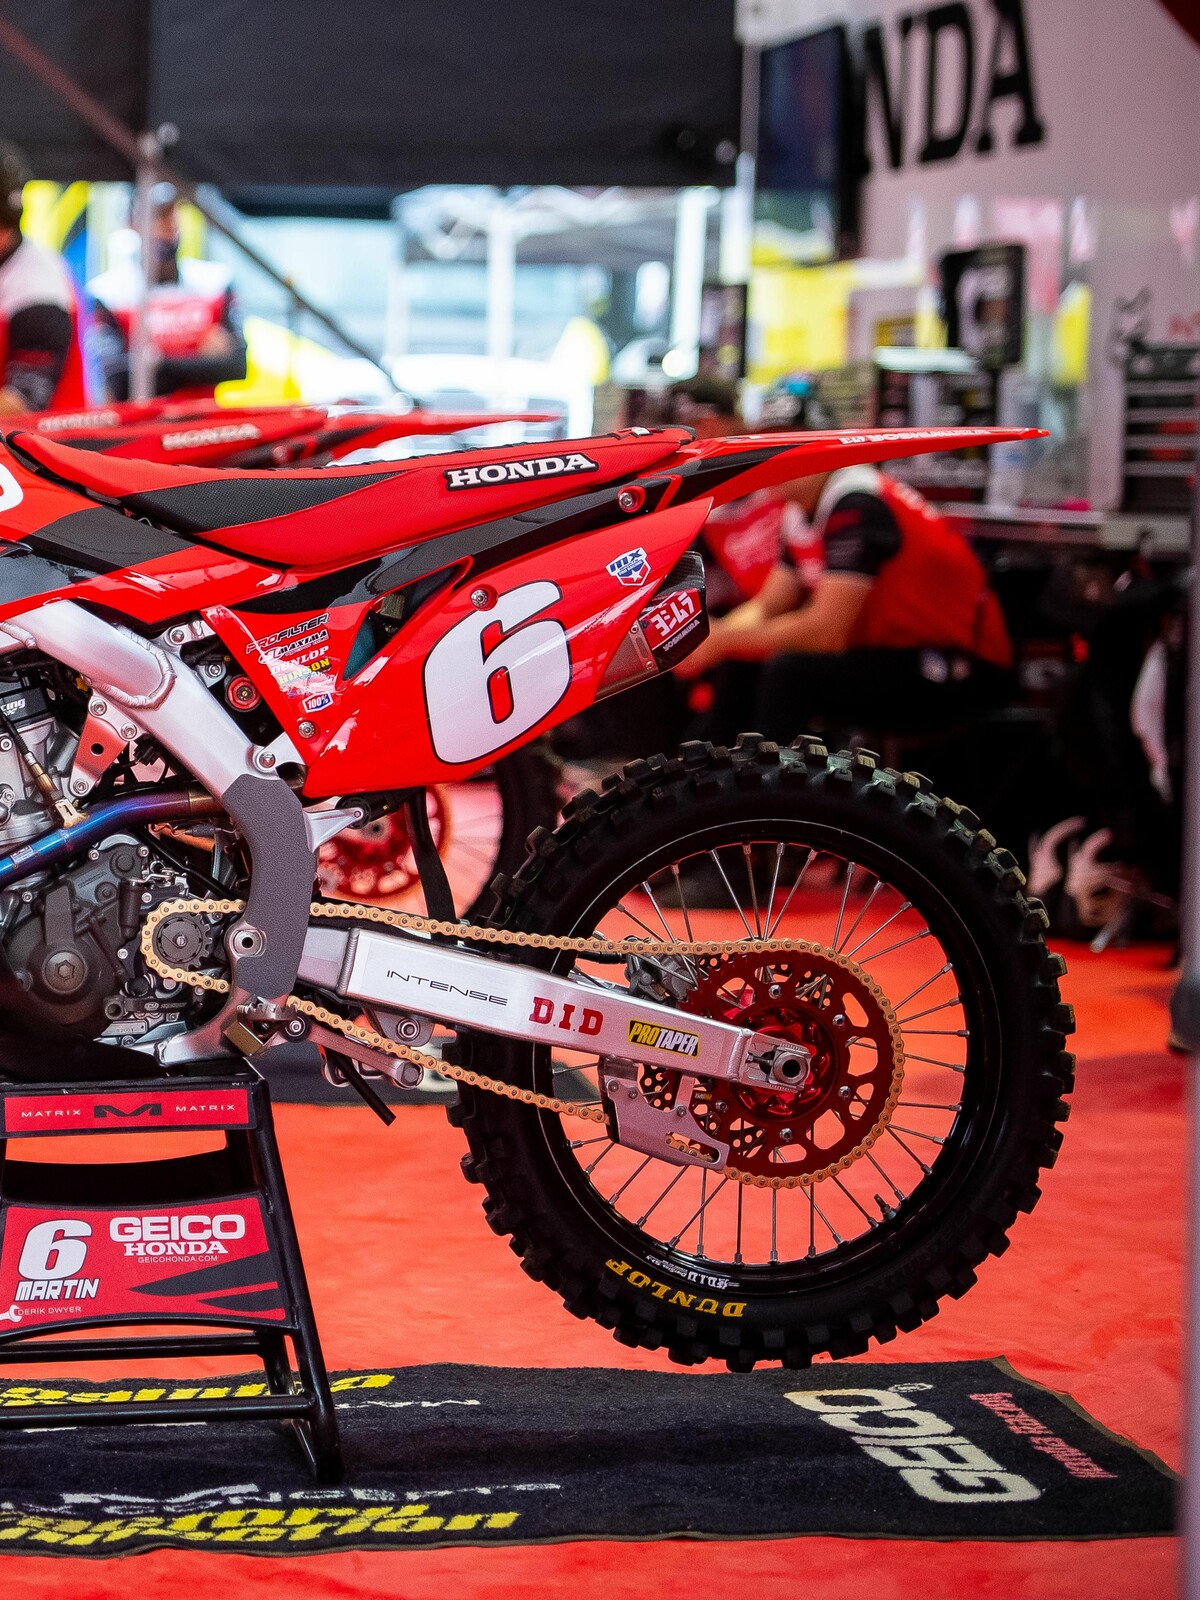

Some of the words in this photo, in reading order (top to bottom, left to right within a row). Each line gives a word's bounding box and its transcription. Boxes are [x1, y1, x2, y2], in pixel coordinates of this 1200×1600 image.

[447, 453, 596, 488] HONDA
[245, 612, 330, 655] PROFILTER
[278, 629, 329, 656] MAXIMA
[662, 619, 700, 652] YOSHIMURA
[424, 580, 572, 765] 6
[306, 693, 330, 711] 100%
[386, 969, 509, 1007] INTENSE
[528, 996, 604, 1037] D.I.D
[21, 1108, 81, 1119] MATRIX
[175, 1103, 236, 1113] MATRIX
[109, 1213, 246, 1243] GEICO
[17, 1218, 93, 1281] 6
[123, 1240, 229, 1257] HONDA
[137, 1254, 219, 1264] GEICOHONDA.COM
[14, 1278, 101, 1302] MARTIN
[604, 1258, 748, 1318] DUNLOP
[48, 1306, 82, 1315] DWYER
[783, 1388, 1043, 1503] GEICO
